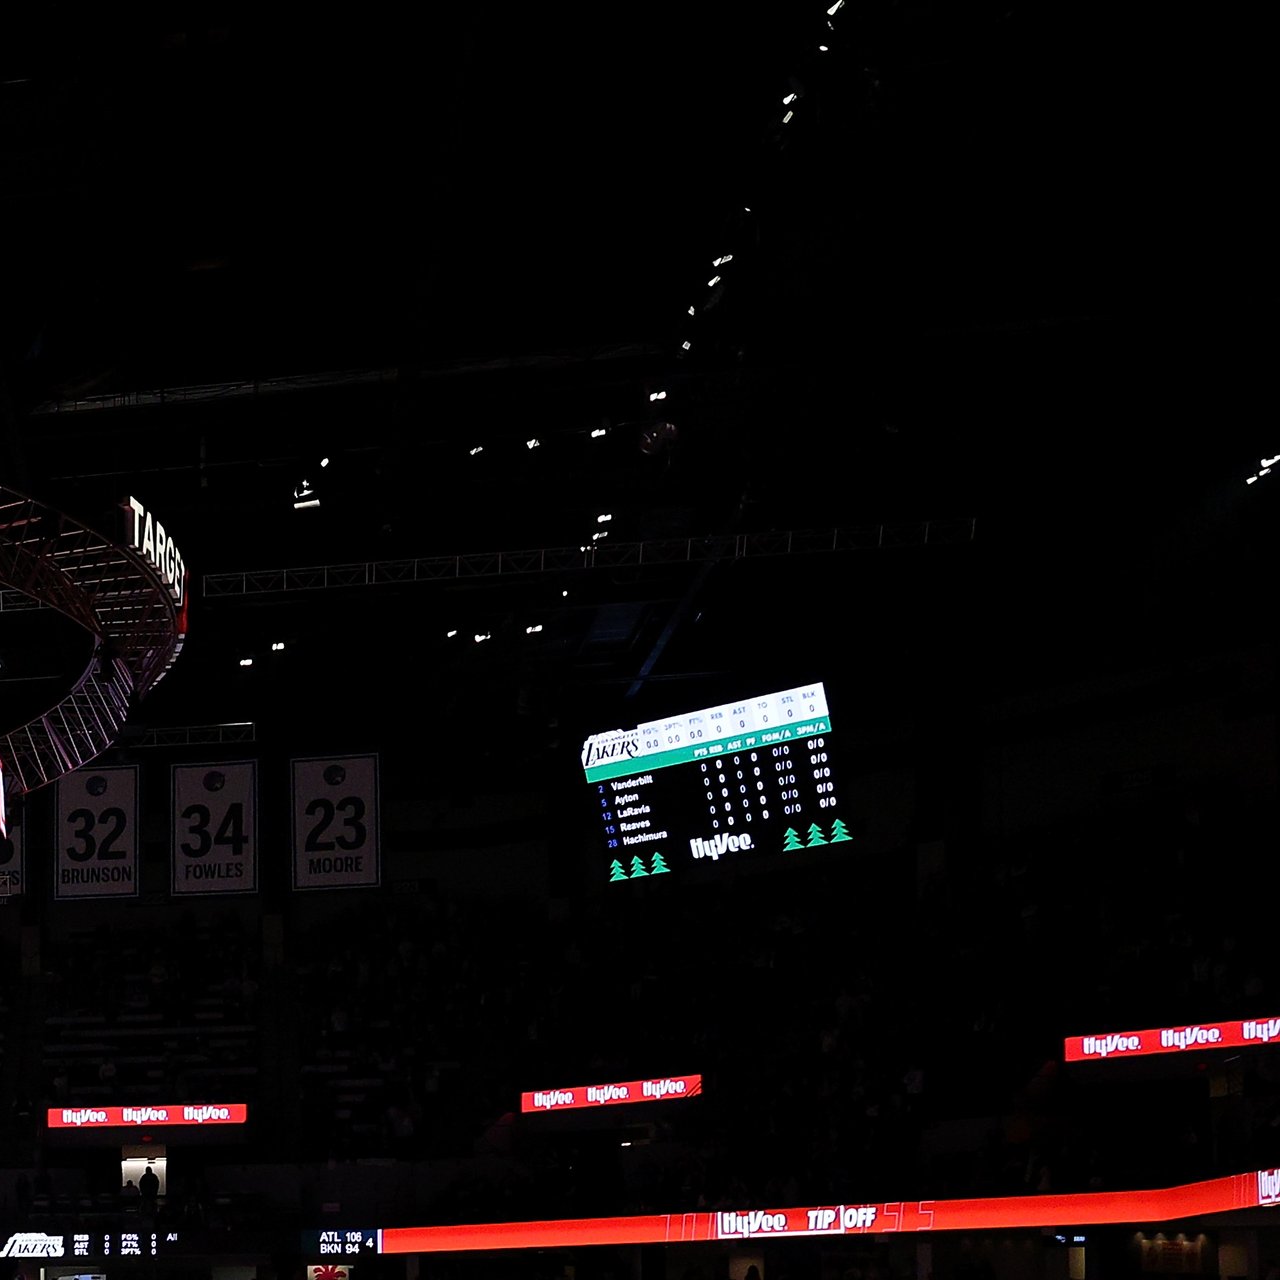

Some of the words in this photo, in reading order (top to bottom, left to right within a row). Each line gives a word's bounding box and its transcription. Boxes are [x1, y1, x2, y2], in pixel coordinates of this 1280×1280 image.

[129, 495, 185, 606] TARGET
[646, 740, 658, 748] 0.0
[668, 735, 680, 743] 0.0
[690, 730, 702, 739] 0.0
[717, 725, 721, 733] 0
[810, 704, 814, 712] 0
[585, 738, 639, 766] LAKERS
[611, 775, 653, 790] Vanderbilt
[773, 746, 789, 756] 0/0
[808, 738, 824, 749] 0/0
[615, 794, 639, 805] Ayton
[776, 760, 792, 771] 0/0
[811, 753, 827, 764] 0/0
[617, 805, 650, 818] LaRavia
[779, 775, 795, 785] 0/0
[814, 767, 830, 779] 0/0
[605, 826, 615, 834] 15
[620, 820, 650, 832] Reaves
[782, 789, 798, 800] 0/0
[817, 782, 833, 793] 0/0
[608, 840, 617, 848] 28
[623, 831, 667, 845] Hachimura
[785, 804, 801, 814] 0/0
[820, 797, 836, 808] 0/0
[66, 808, 126, 861] 32
[180, 803, 249, 858] 34
[304, 797, 366, 853] 23
[690, 832, 752, 860] HyVee
[61, 866, 132, 885] BRUNSON
[185, 861, 244, 880] FOWLES
[308, 857, 363, 875] MOORE
[1083, 1035, 1141, 1056] HyVee
[1161, 1027, 1222, 1049] HyVee
[534, 1090, 574, 1110] HyVee
[587, 1085, 629, 1104] HyVee
[642, 1079, 686, 1098] HyVee
[63, 1109, 107, 1126] HyVee
[123, 1107, 168, 1124] HyVee
[184, 1106, 230, 1123] HyVee
[320, 1231, 341, 1242] ATL
[722, 1211, 787, 1238] HyVee
[808, 1209, 835, 1230] TIP
[844, 1207, 877, 1228] OFF
[7, 1239, 57, 1257] LAKERS
[320, 1243, 341, 1254] BKN
[345, 1243, 359, 1254] 94
[366, 1238, 374, 1248] 4
